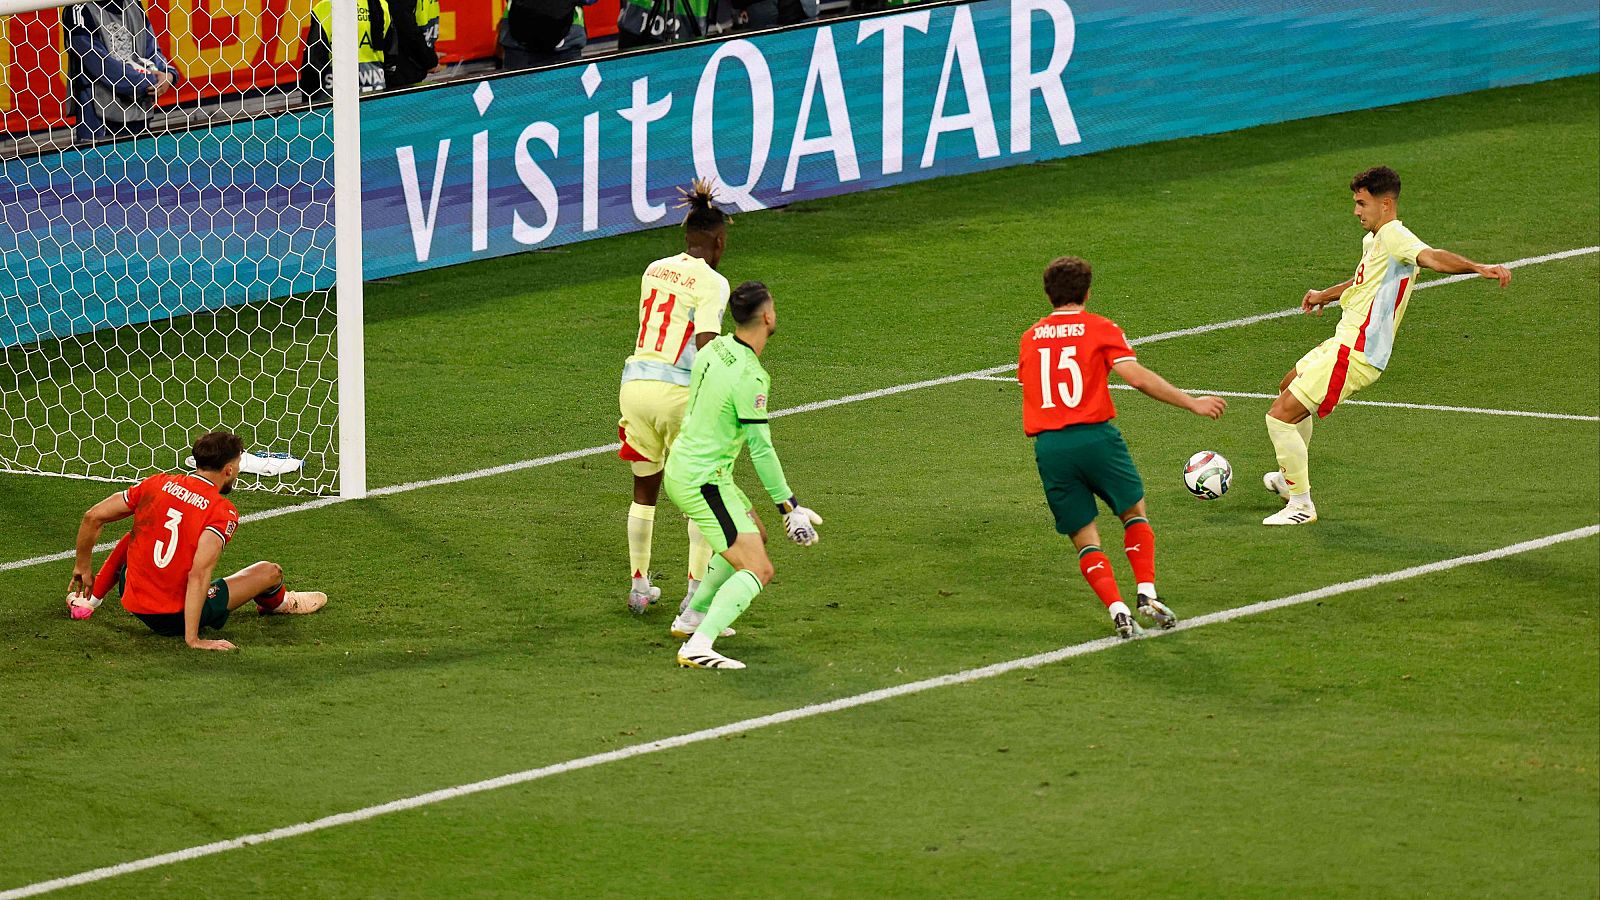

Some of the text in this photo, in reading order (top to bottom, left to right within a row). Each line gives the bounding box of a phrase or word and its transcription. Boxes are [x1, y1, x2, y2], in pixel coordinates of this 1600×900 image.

[638, 288, 676, 352] 11
[1056, 323, 1086, 339] NEVES
[1037, 345, 1084, 409] 15
[153, 507, 184, 569] 3
